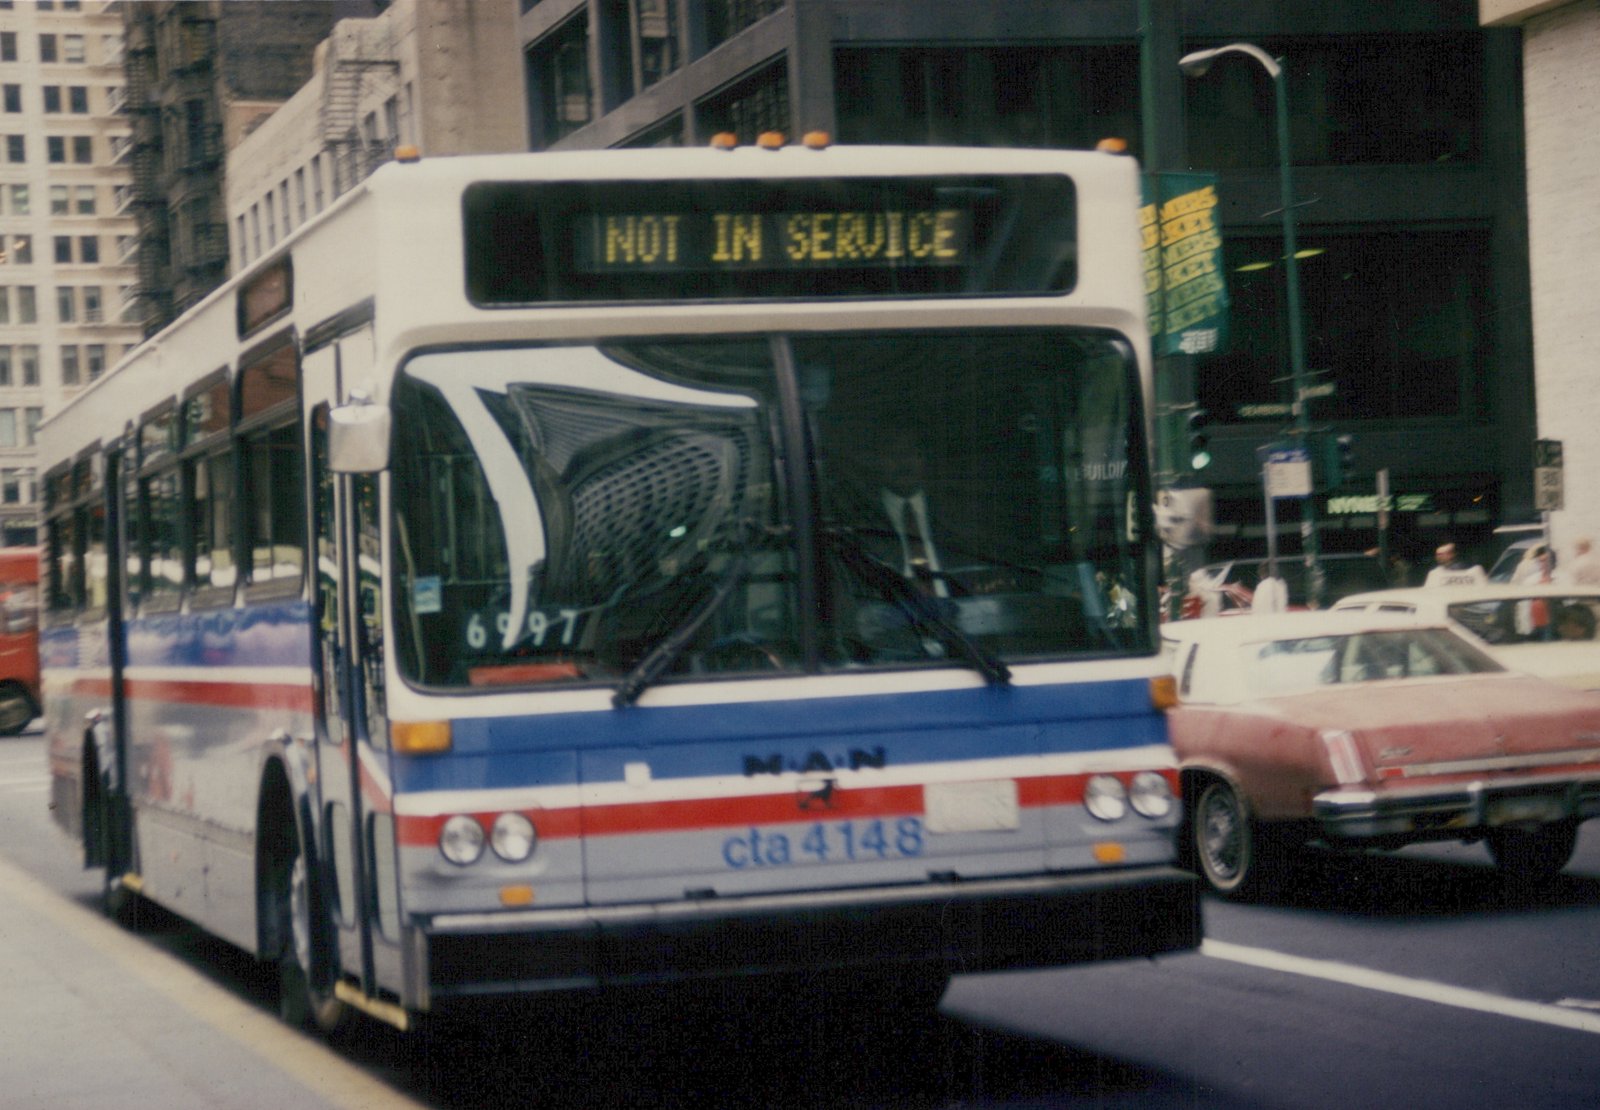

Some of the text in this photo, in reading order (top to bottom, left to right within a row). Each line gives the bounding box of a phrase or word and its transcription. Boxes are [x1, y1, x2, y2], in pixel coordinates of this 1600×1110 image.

[606, 211, 960, 263] NOT IN SERVICE
[722, 816, 923, 869] cta 4148
